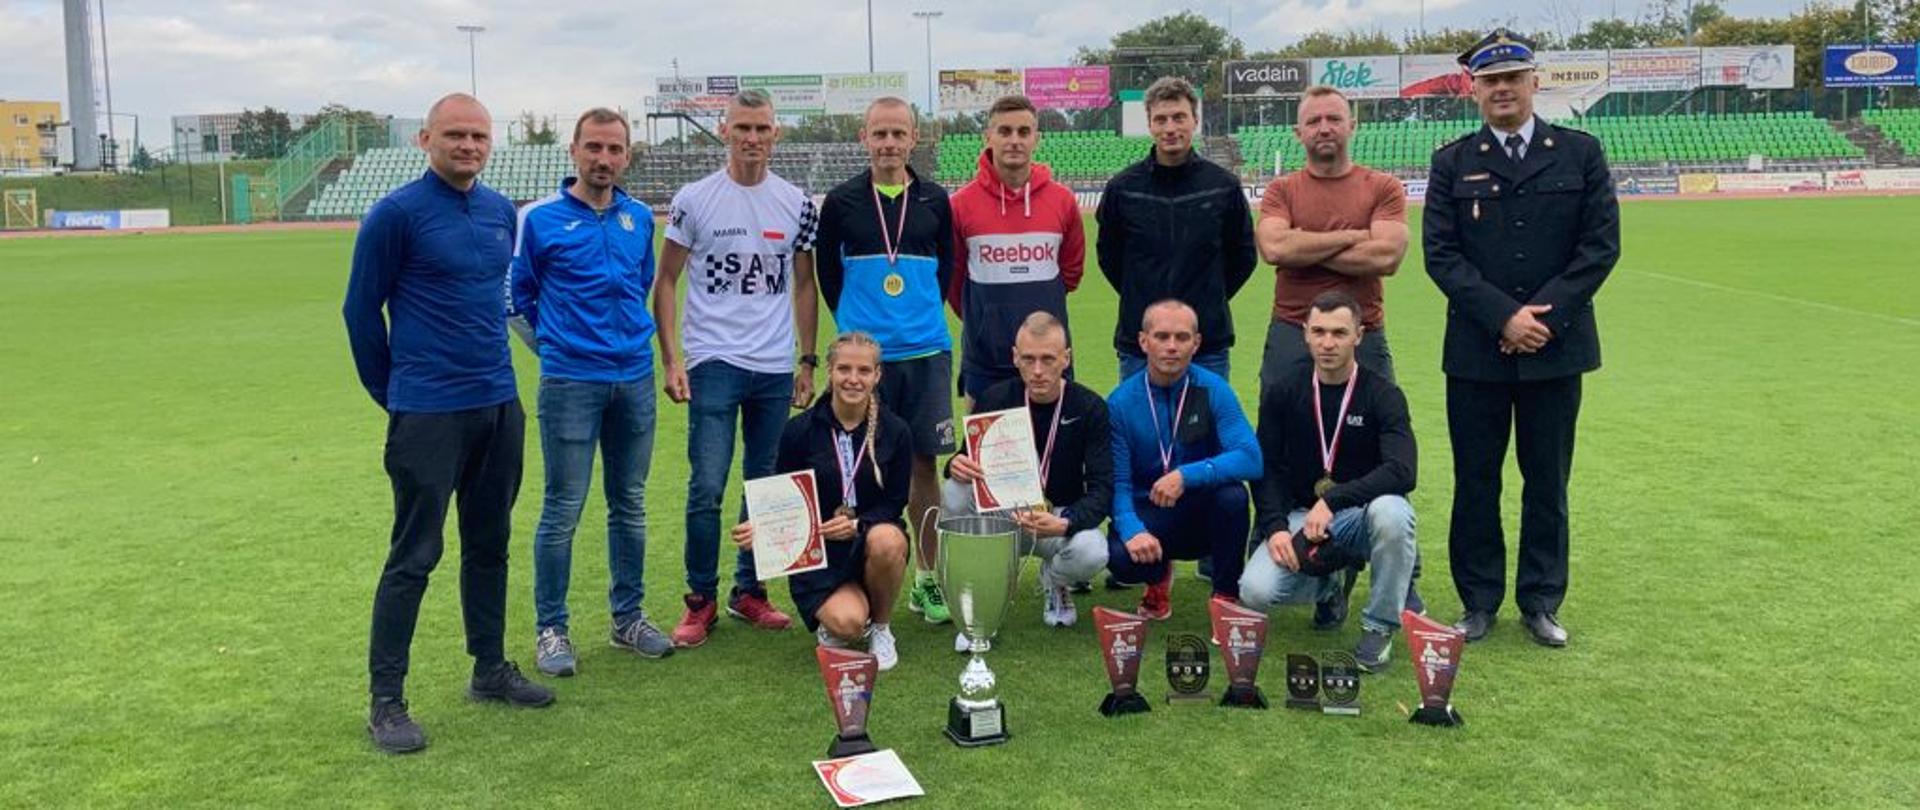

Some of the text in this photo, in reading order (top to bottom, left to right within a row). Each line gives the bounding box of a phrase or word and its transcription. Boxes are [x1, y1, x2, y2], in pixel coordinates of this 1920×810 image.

[842, 75, 905, 88] PRESTIGE
[1235, 65, 1298, 82] vadain
[979, 242, 1054, 263] Reebok
